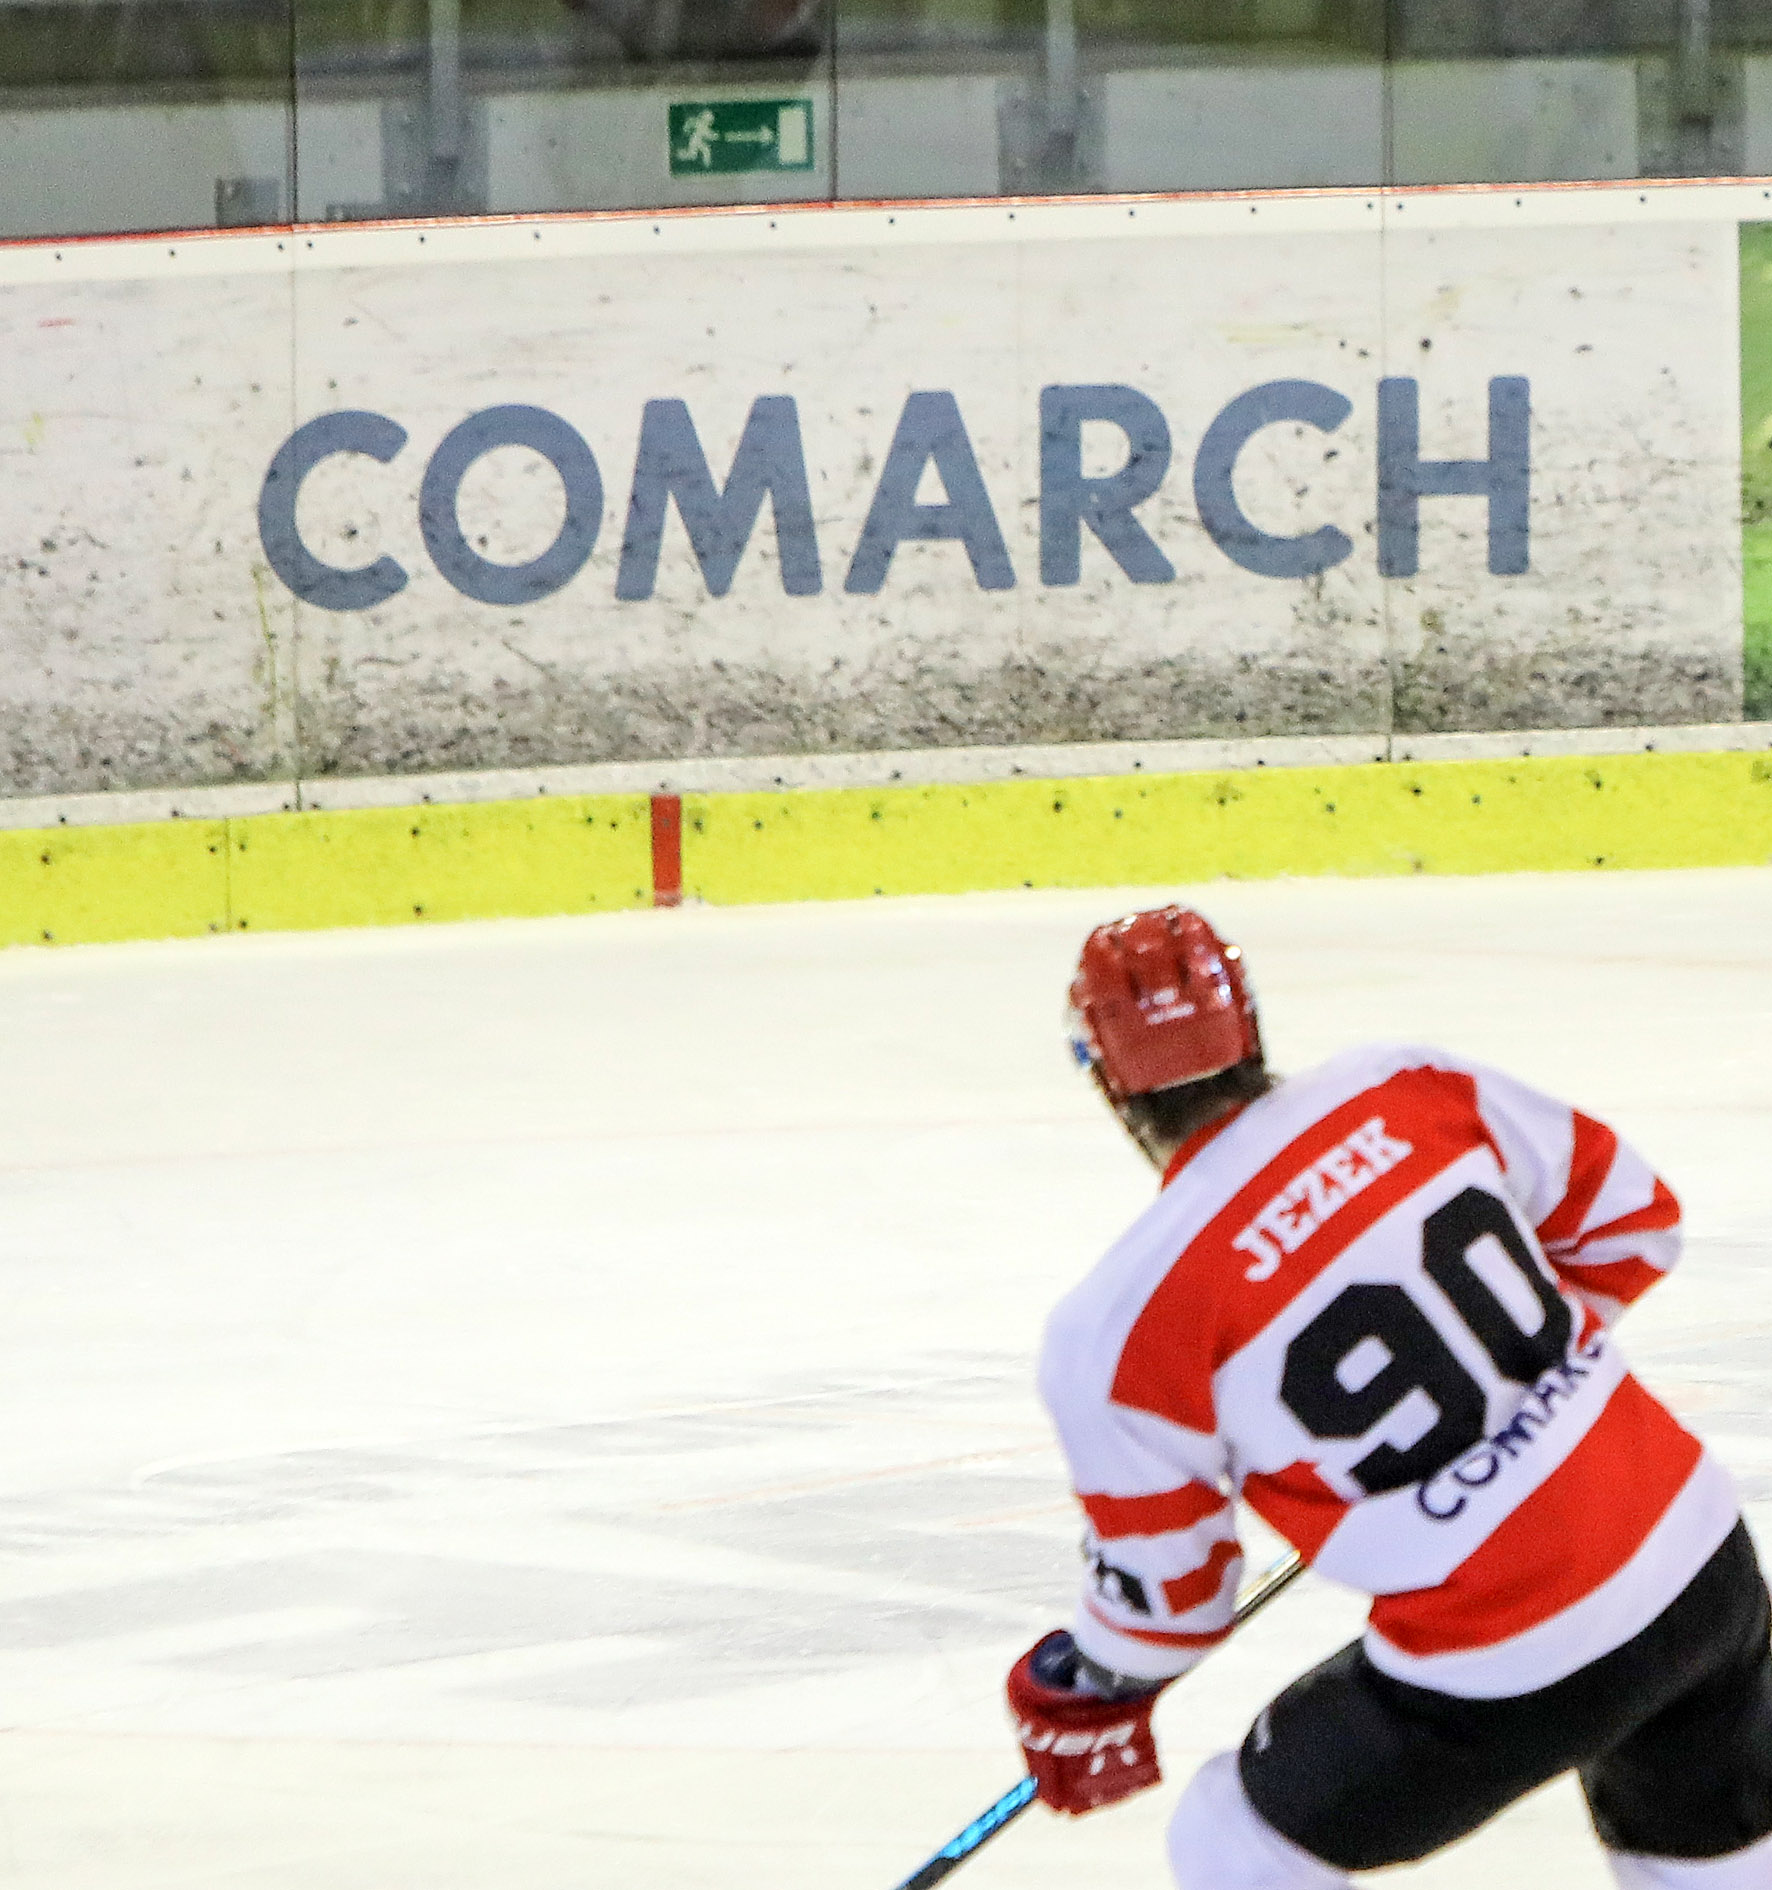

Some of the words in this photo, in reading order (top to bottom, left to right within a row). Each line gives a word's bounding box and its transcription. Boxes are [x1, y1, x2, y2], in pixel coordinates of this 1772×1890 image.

[256, 375, 1532, 611] COMARCH
[1231, 1115, 1415, 1283] JEZEK
[1279, 1186, 1572, 1495] 90
